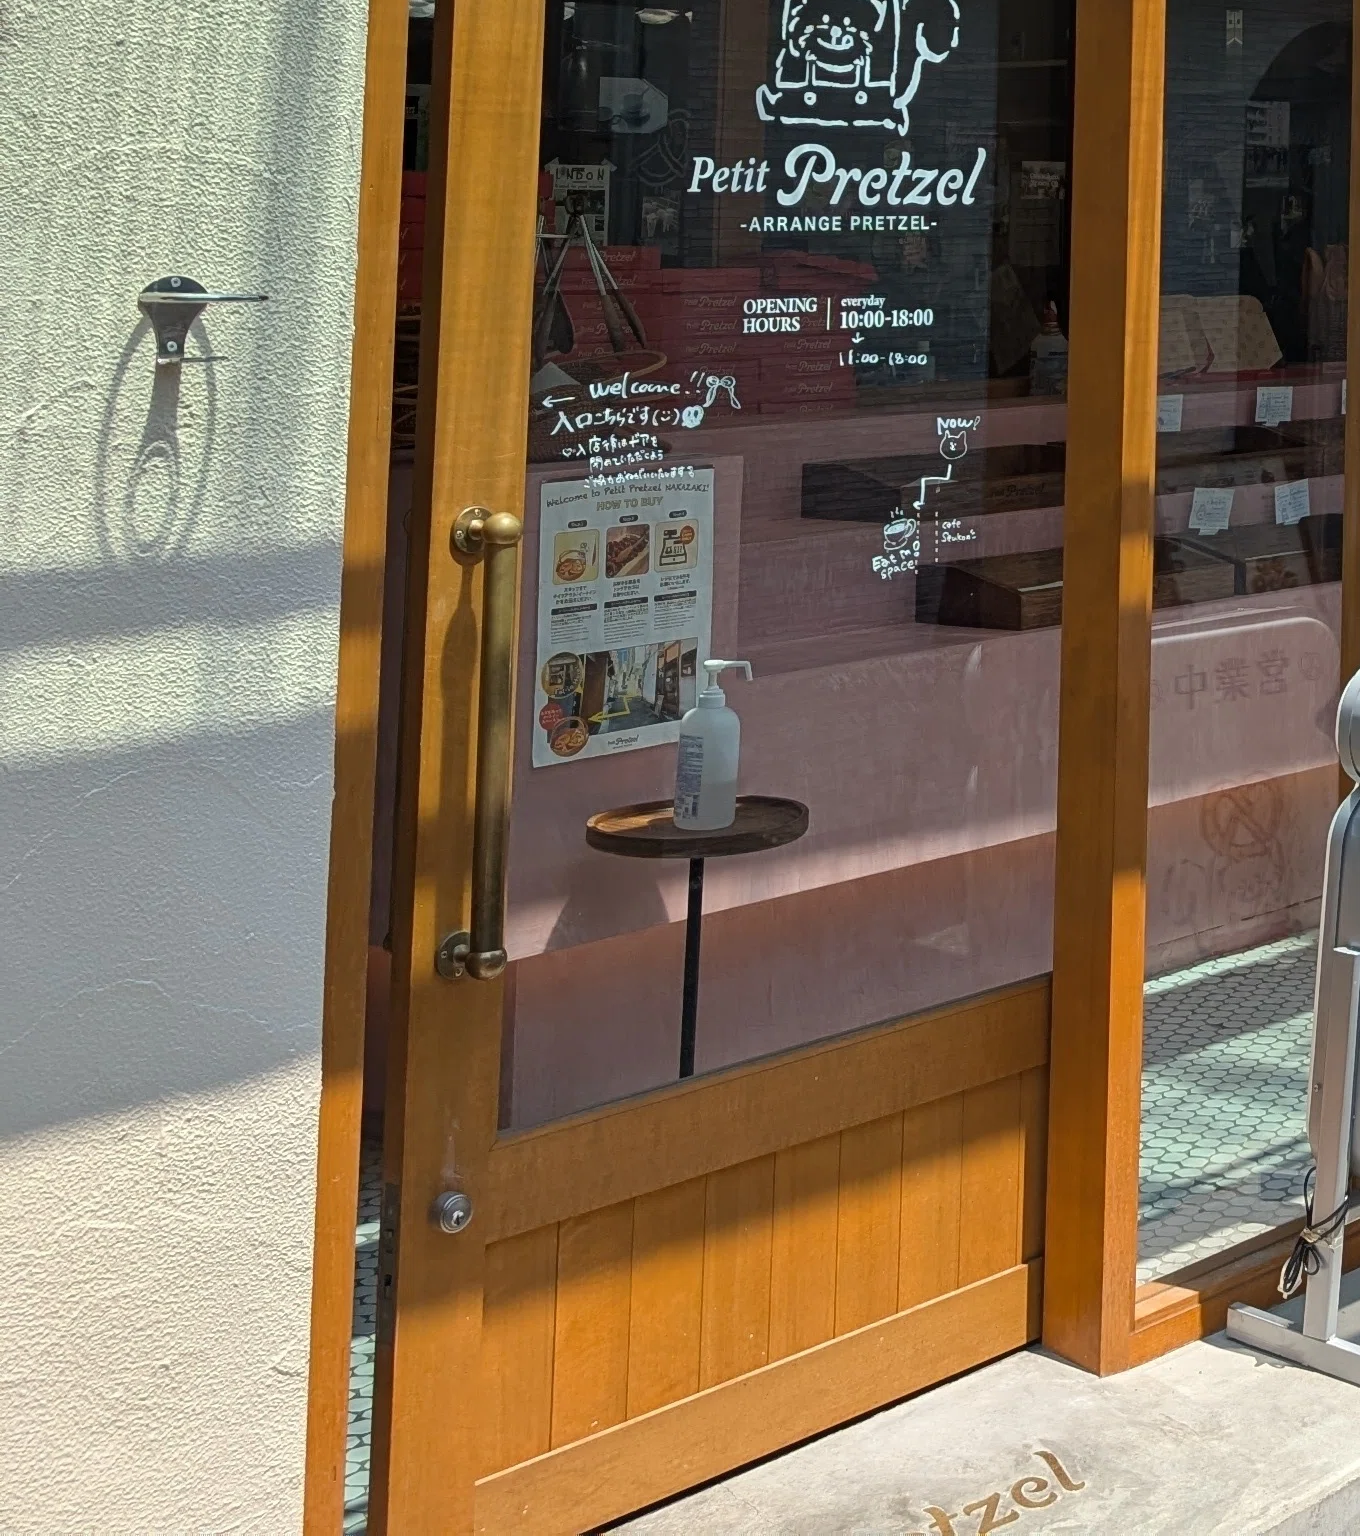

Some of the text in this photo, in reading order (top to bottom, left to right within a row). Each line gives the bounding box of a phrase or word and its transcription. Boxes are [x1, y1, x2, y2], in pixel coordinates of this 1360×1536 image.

[687, 143, 987, 206] Petit Pretzel
[740, 213, 938, 233] -ARRANGE PRETZEL-
[743, 297, 818, 314] OPENING
[840, 295, 886, 309] everyday
[743, 316, 800, 333] HOURS
[840, 308, 934, 330] 10:00-18:00
[604, 484, 626, 496] Petit
[628, 483, 662, 494] Pretzel
[596, 496, 664, 511] HOW TO BUY
[922, 1450, 1086, 1536] tzel
